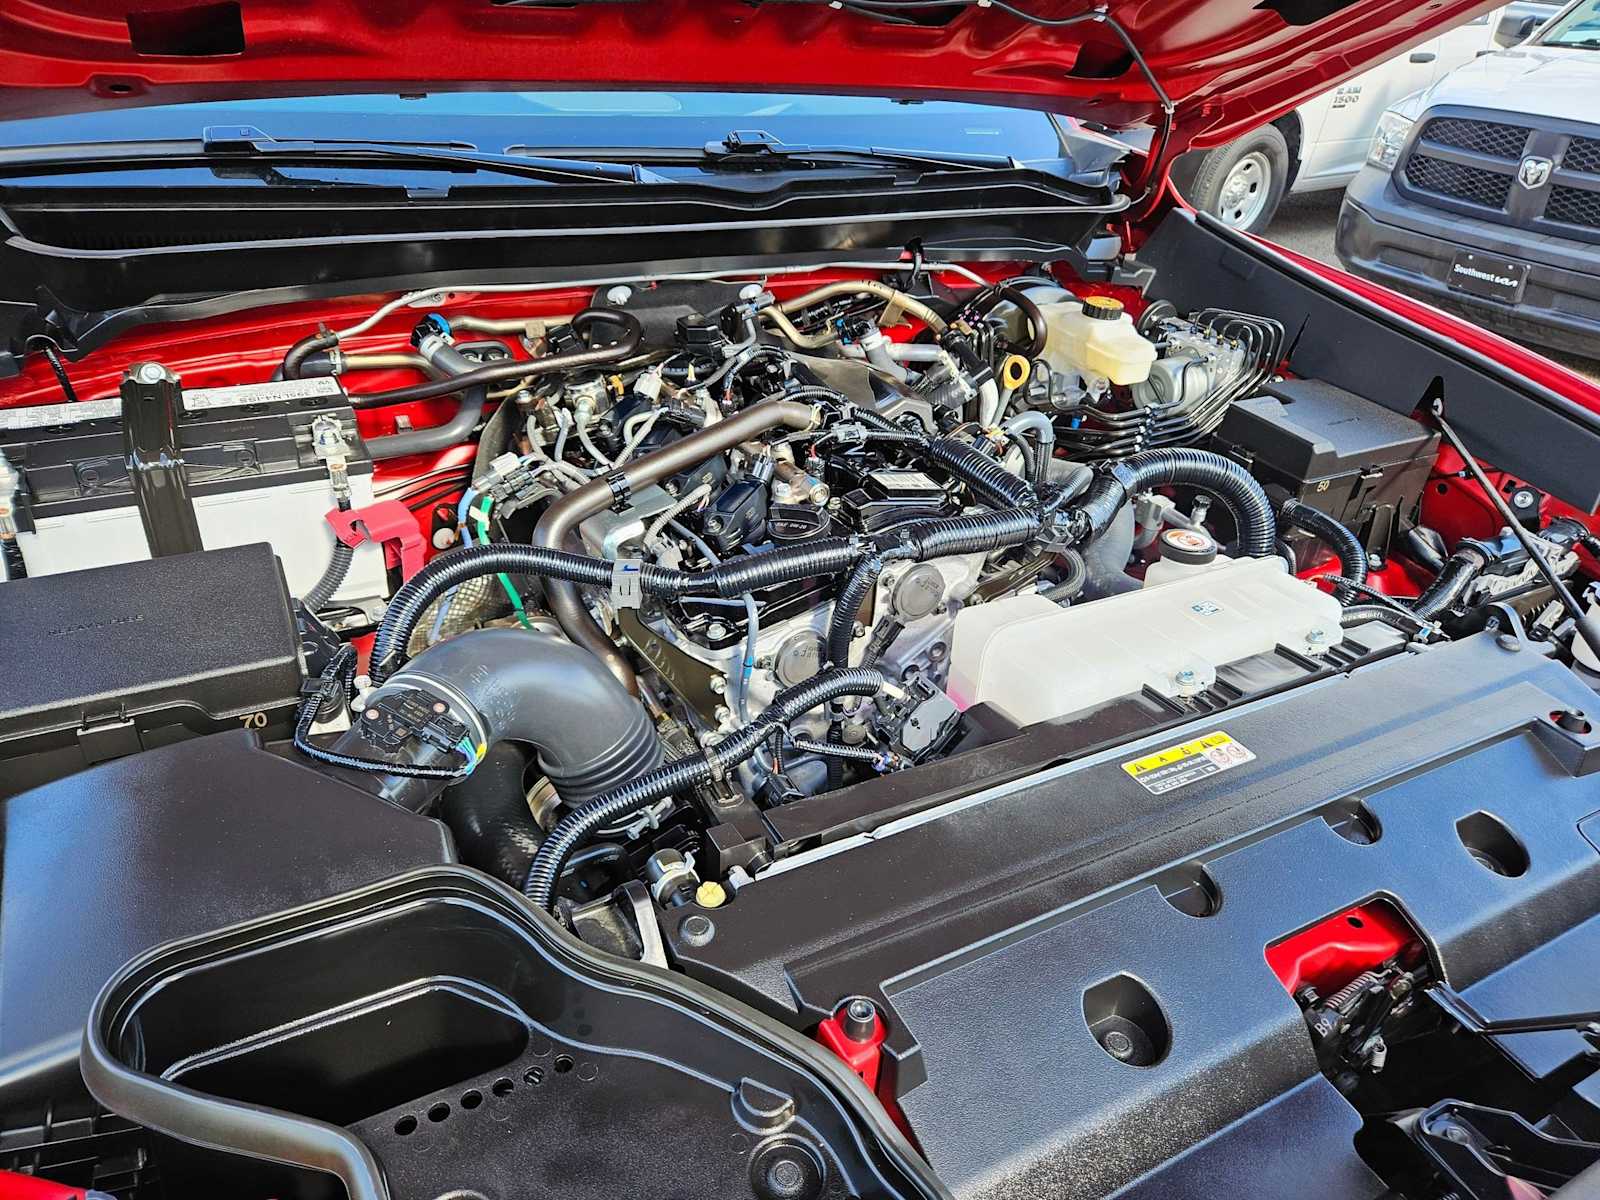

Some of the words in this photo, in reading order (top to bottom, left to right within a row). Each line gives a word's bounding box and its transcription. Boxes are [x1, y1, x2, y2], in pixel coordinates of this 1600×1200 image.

[1334, 95, 1360, 103] 1500
[1454, 264, 1495, 282] Southwest
[1317, 479, 1330, 493] 50
[239, 711, 267, 729] 70
[1314, 1018, 1332, 1037] B9
